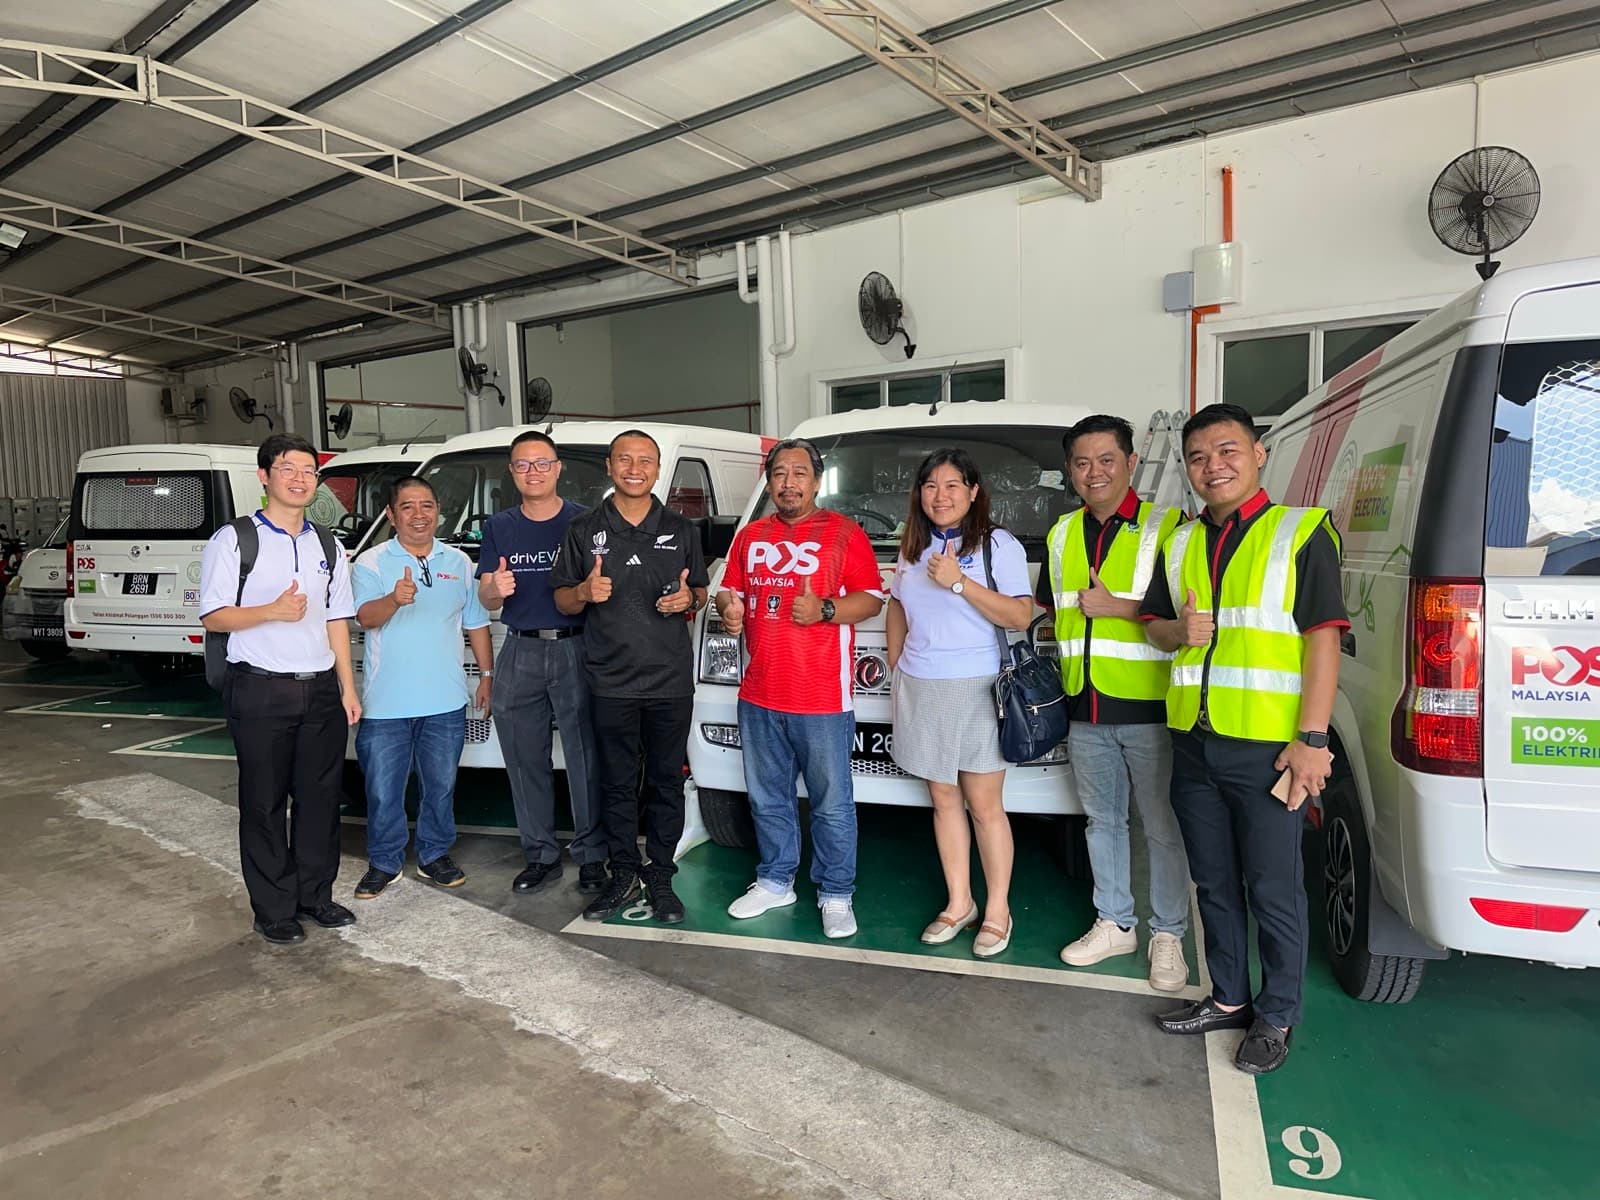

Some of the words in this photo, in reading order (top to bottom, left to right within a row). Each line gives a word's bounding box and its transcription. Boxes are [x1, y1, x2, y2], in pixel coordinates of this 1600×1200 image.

[1354, 495, 1390, 517] ELECTRIC
[77, 557, 96, 570] POS
[747, 541, 822, 575] POS
[132, 574, 149, 583] BRN
[130, 584, 149, 594] 2691
[185, 591, 195, 600] 80
[1511, 690, 1591, 702] MALAYSIA
[1522, 725, 1588, 744] 100%
[1522, 744, 1600, 759] ELEKTRI
[1281, 1125, 1342, 1180] 9
